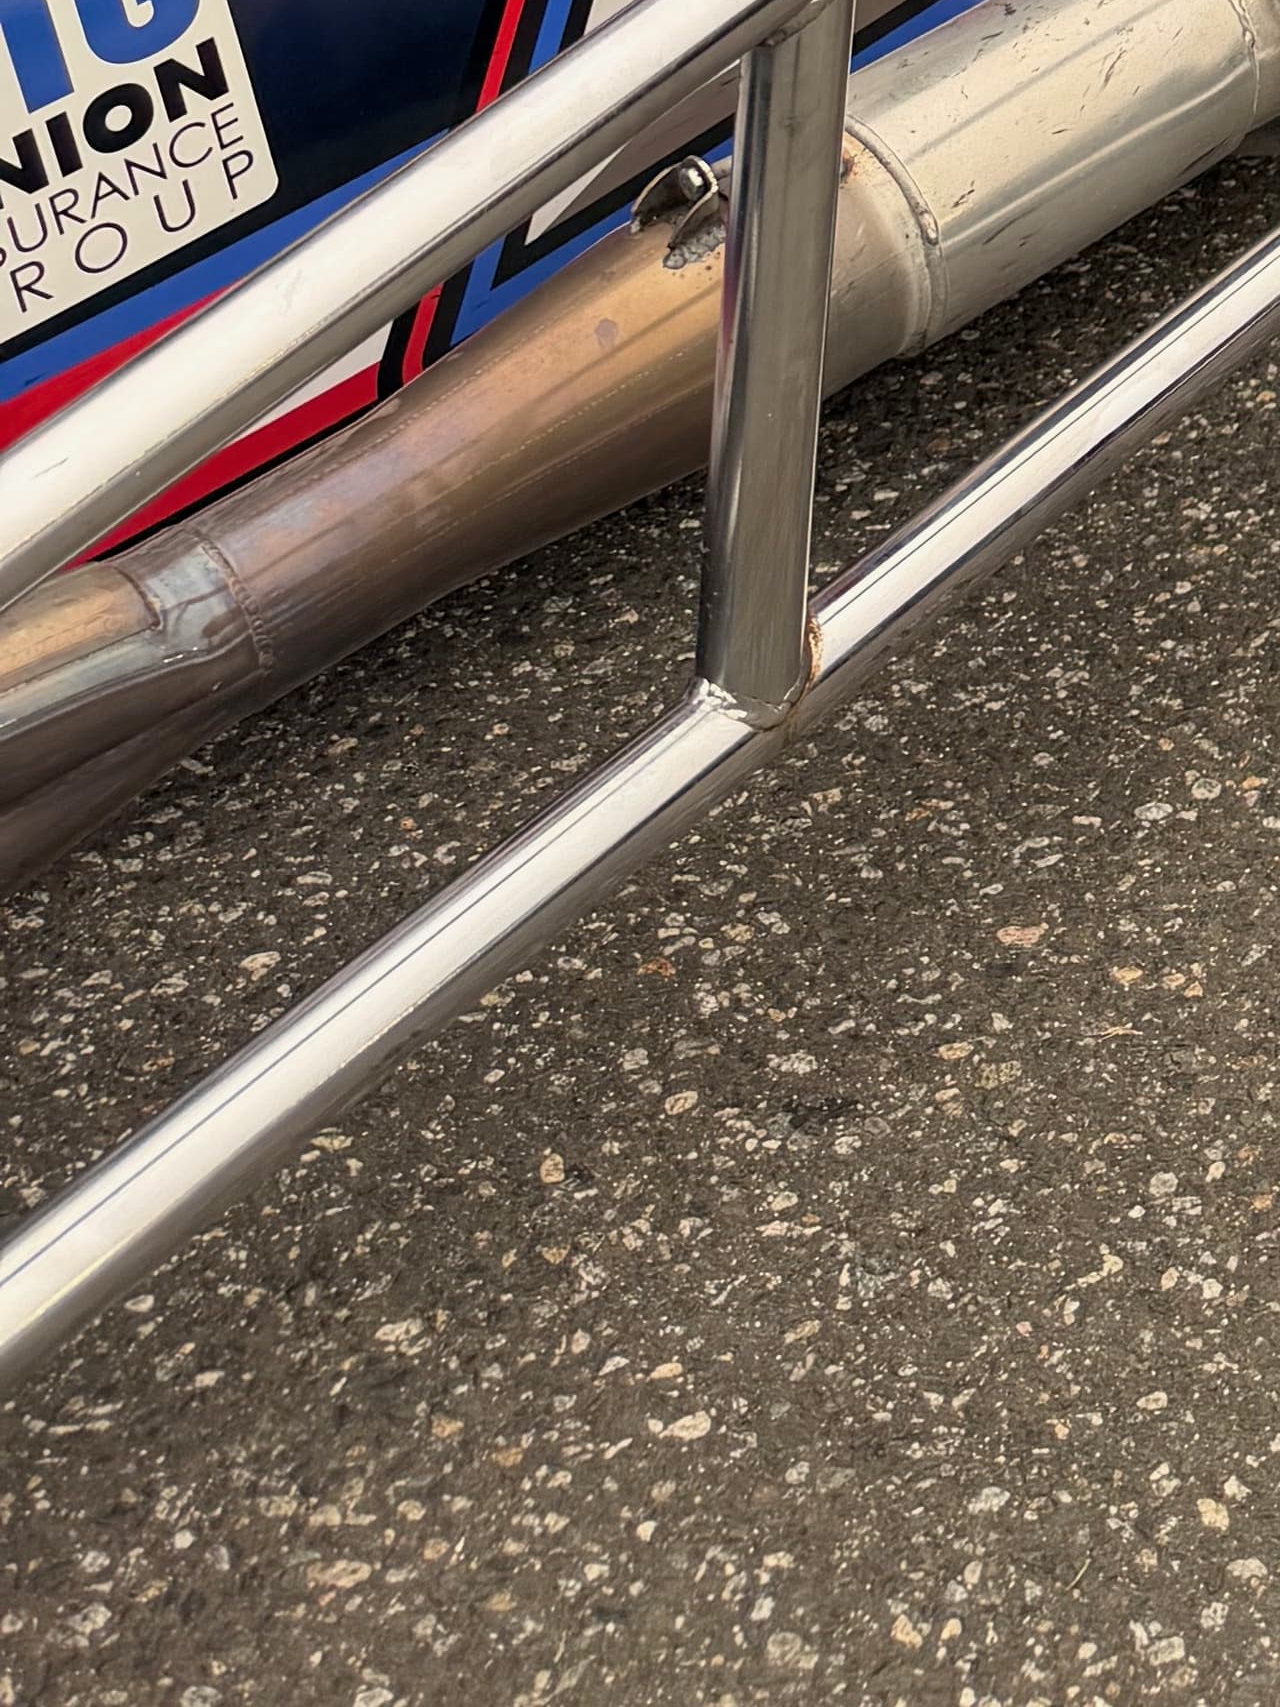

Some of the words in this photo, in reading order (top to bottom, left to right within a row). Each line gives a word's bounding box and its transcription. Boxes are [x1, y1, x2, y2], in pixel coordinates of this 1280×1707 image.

[0, 36, 230, 209] NION
[8, 102, 247, 257] URANCE
[9, 148, 254, 314] ROUP
